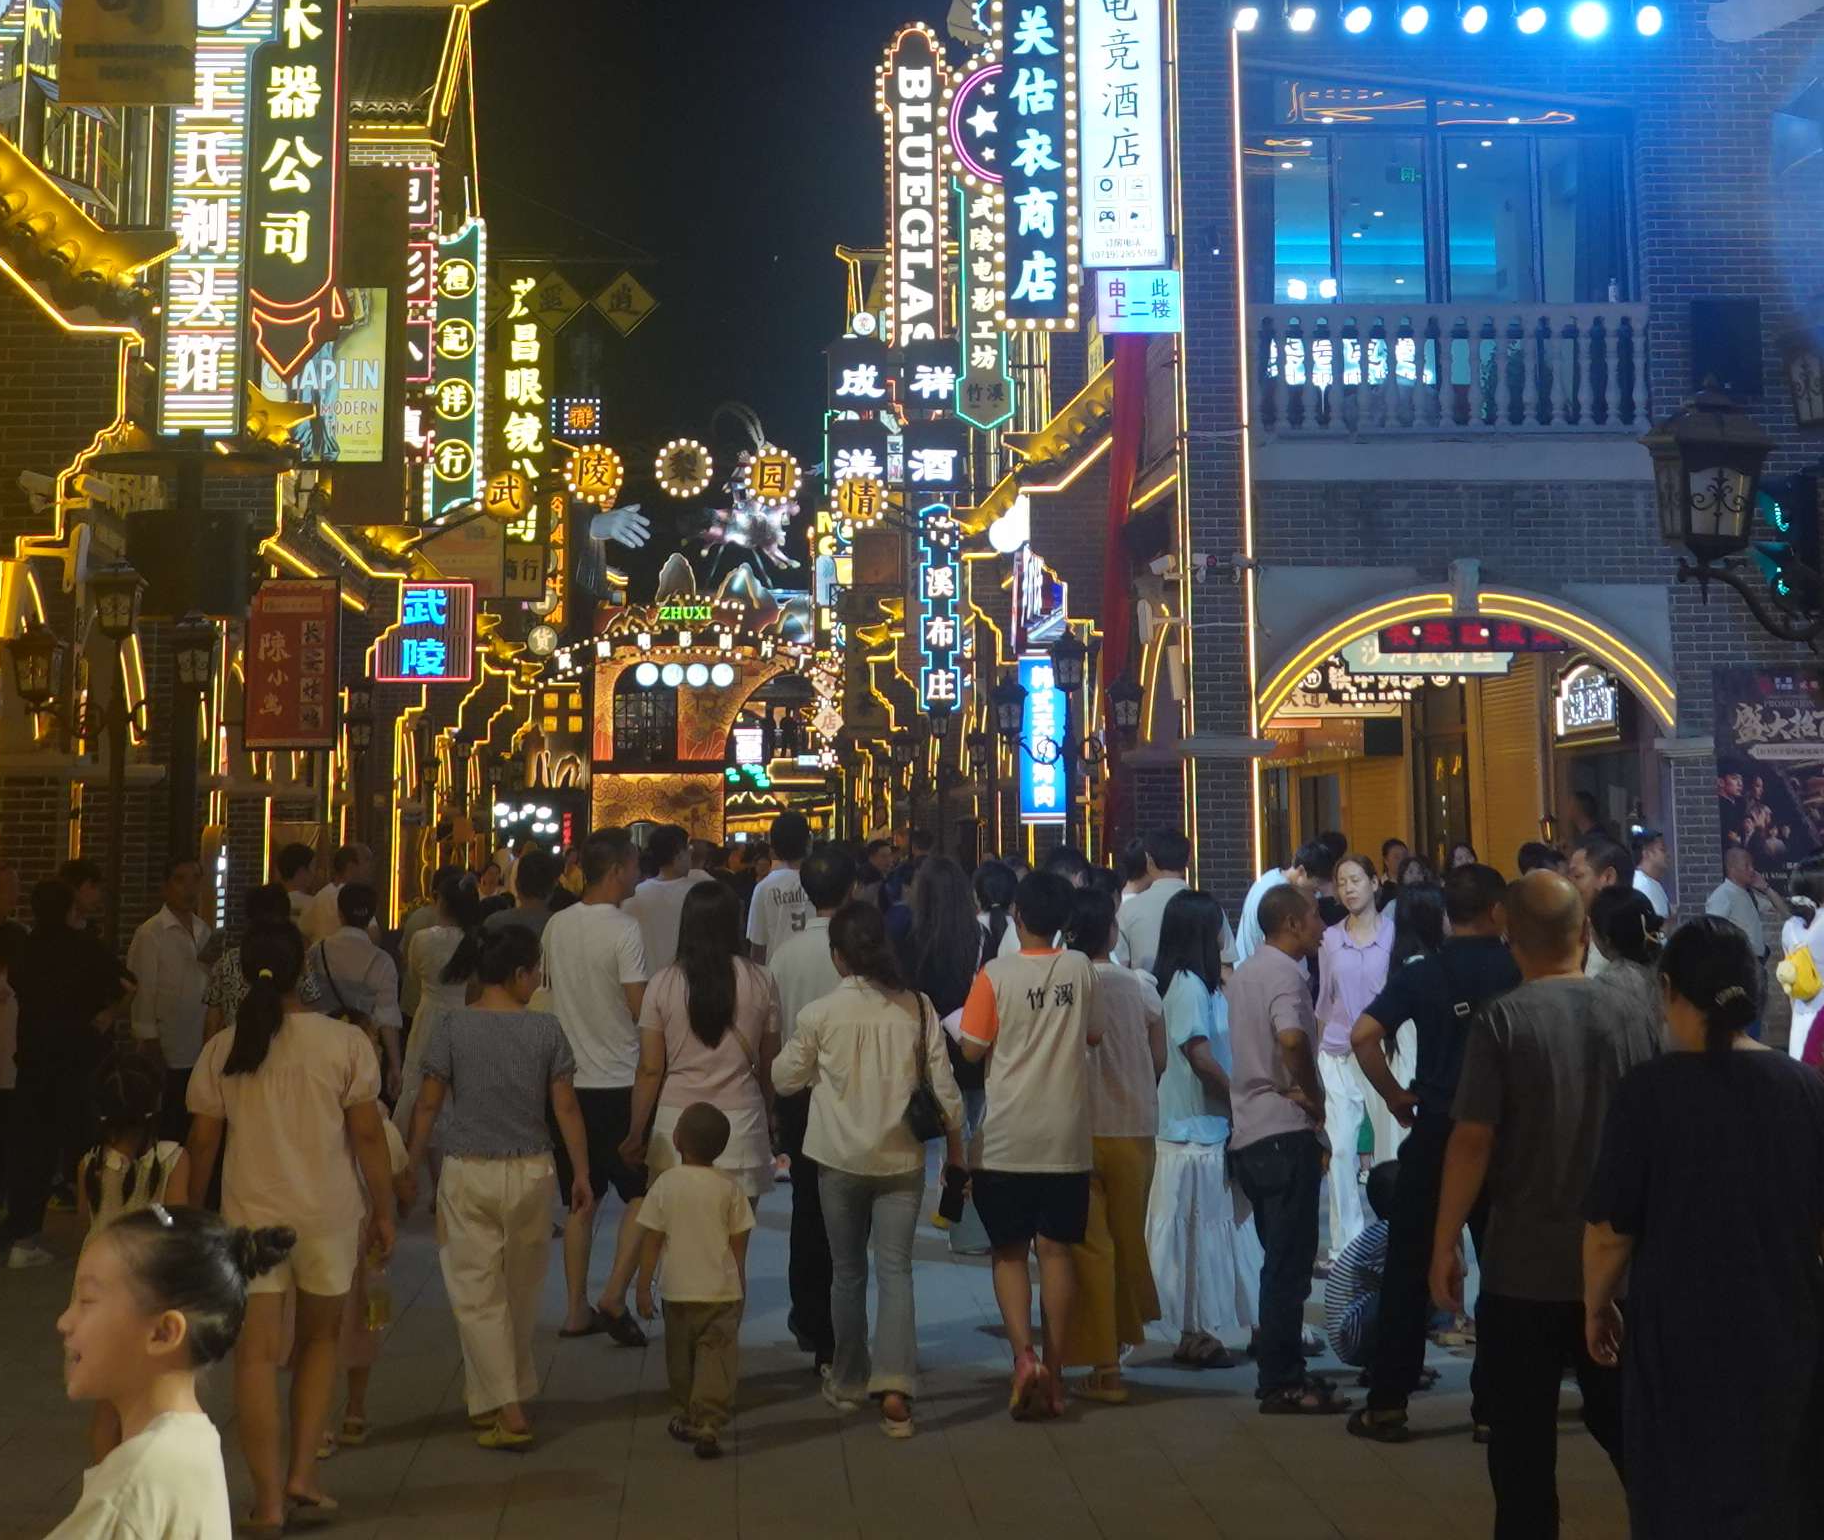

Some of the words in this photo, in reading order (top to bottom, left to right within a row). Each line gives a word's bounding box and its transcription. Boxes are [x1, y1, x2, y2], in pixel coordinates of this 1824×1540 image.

[320, 400, 379, 416] MODERN
[658, 605, 713, 621] ZHUXI
[402, 588, 448, 677] 武陵
[1025, 983, 1076, 1012] 竹溪
